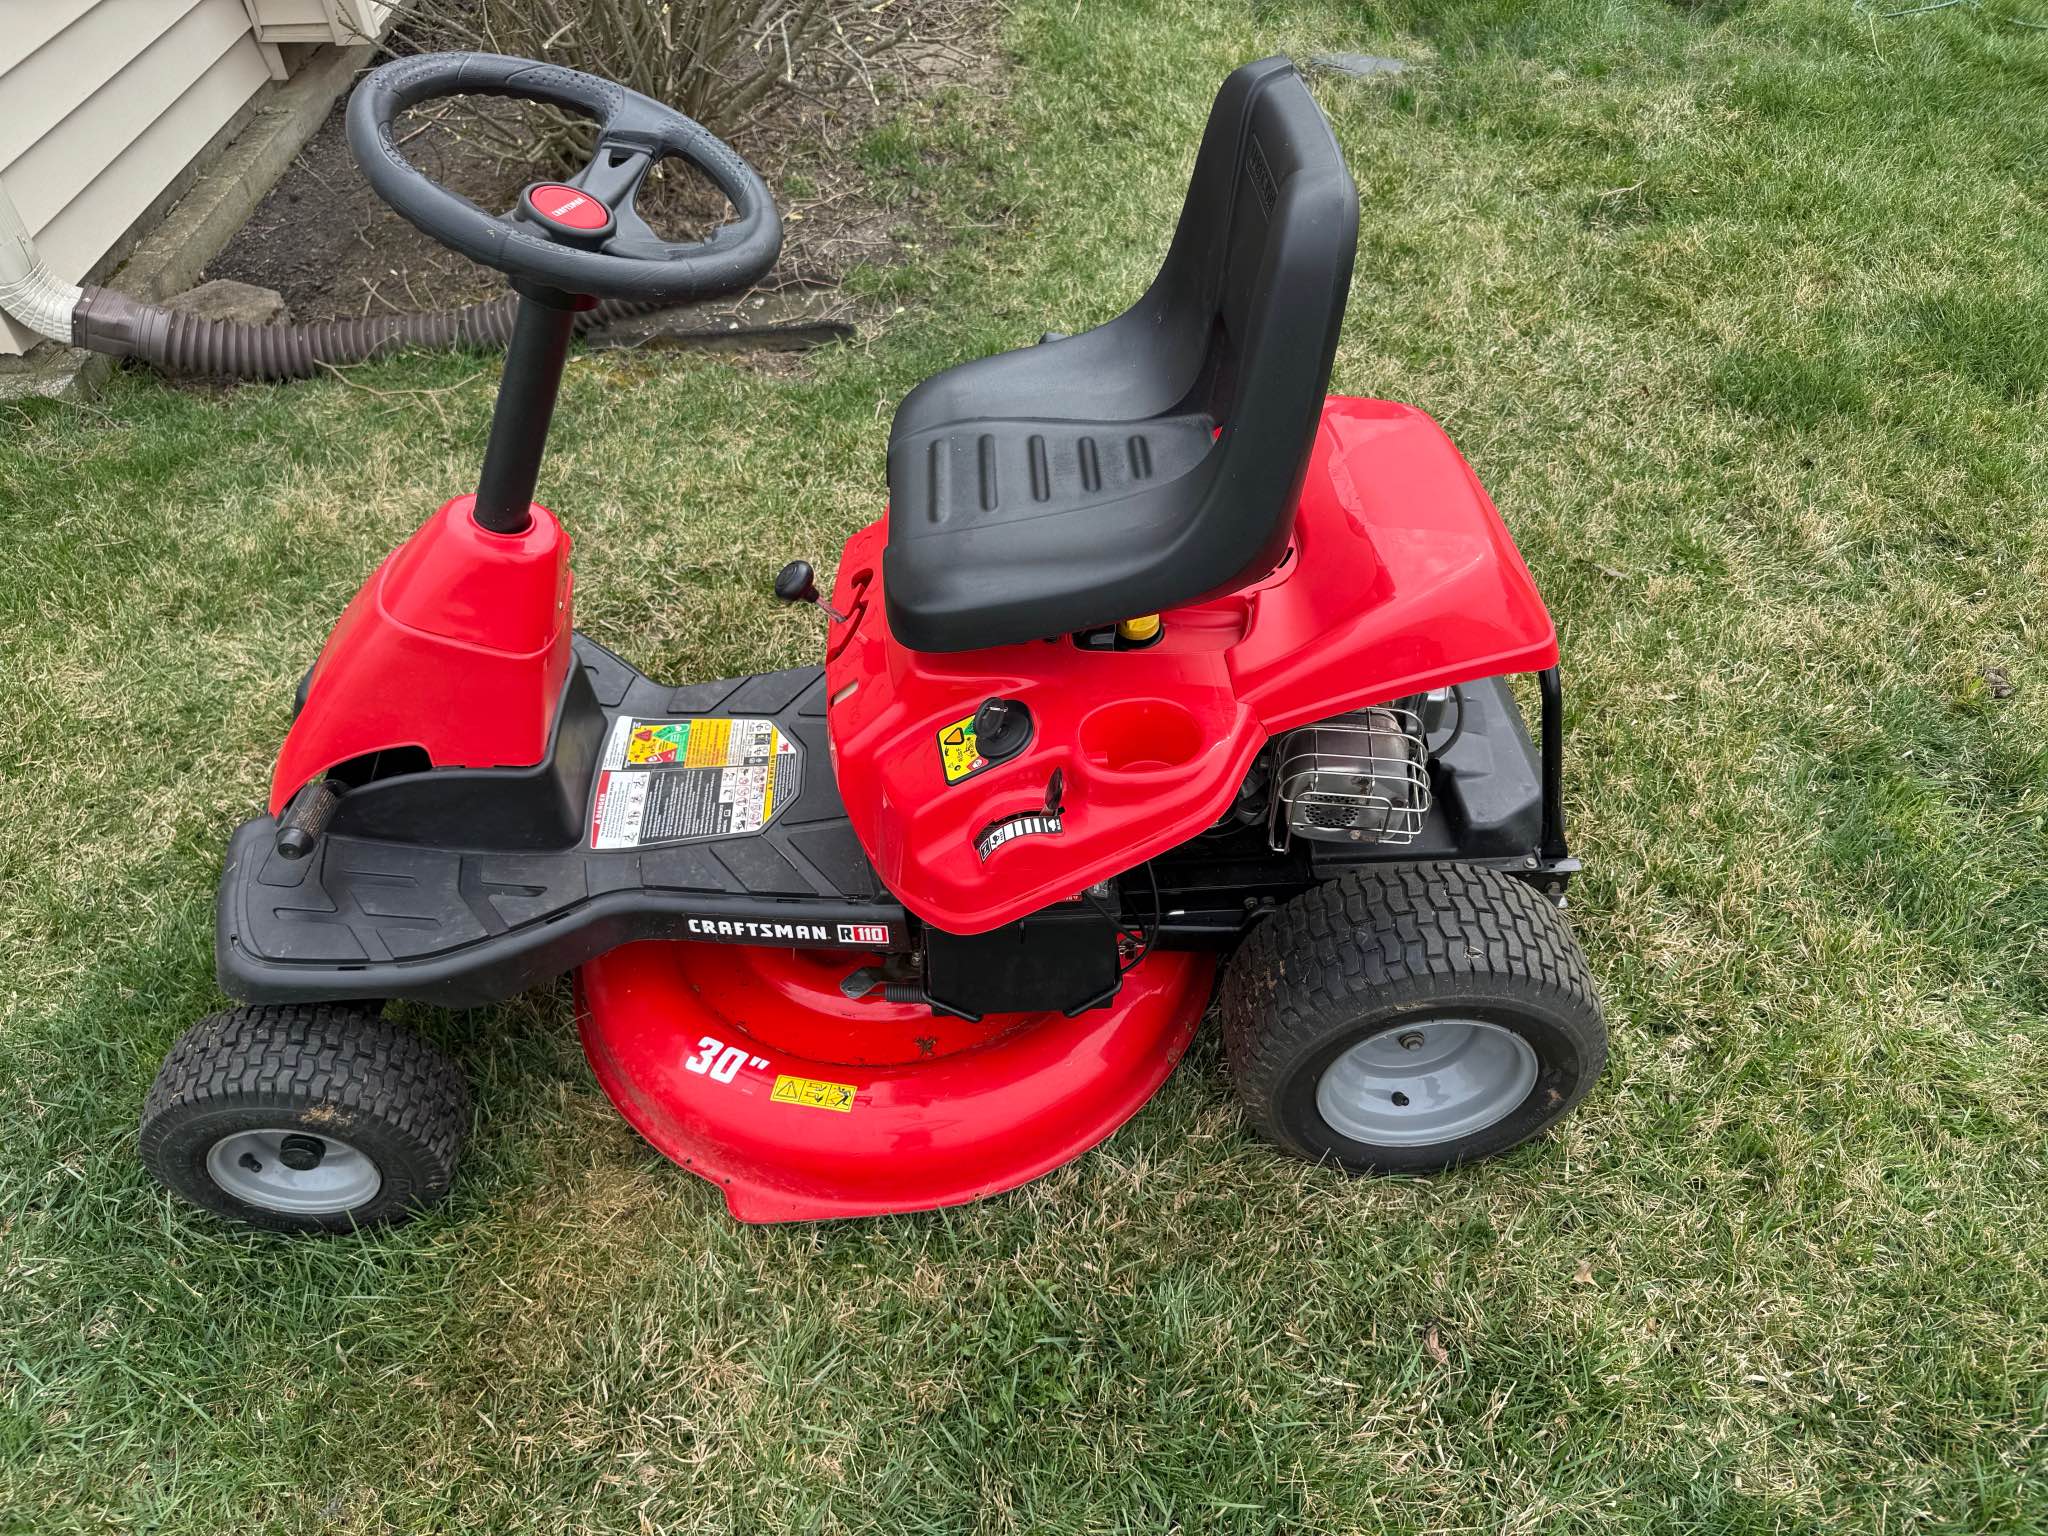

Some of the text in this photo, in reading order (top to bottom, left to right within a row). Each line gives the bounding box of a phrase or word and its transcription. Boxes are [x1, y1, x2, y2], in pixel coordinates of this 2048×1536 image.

[768, 754, 776, 784] WARNING
[595, 793, 606, 818] DANGER
[688, 919, 829, 940] CRAFTSMAN
[684, 1036, 770, 1084] 30"
